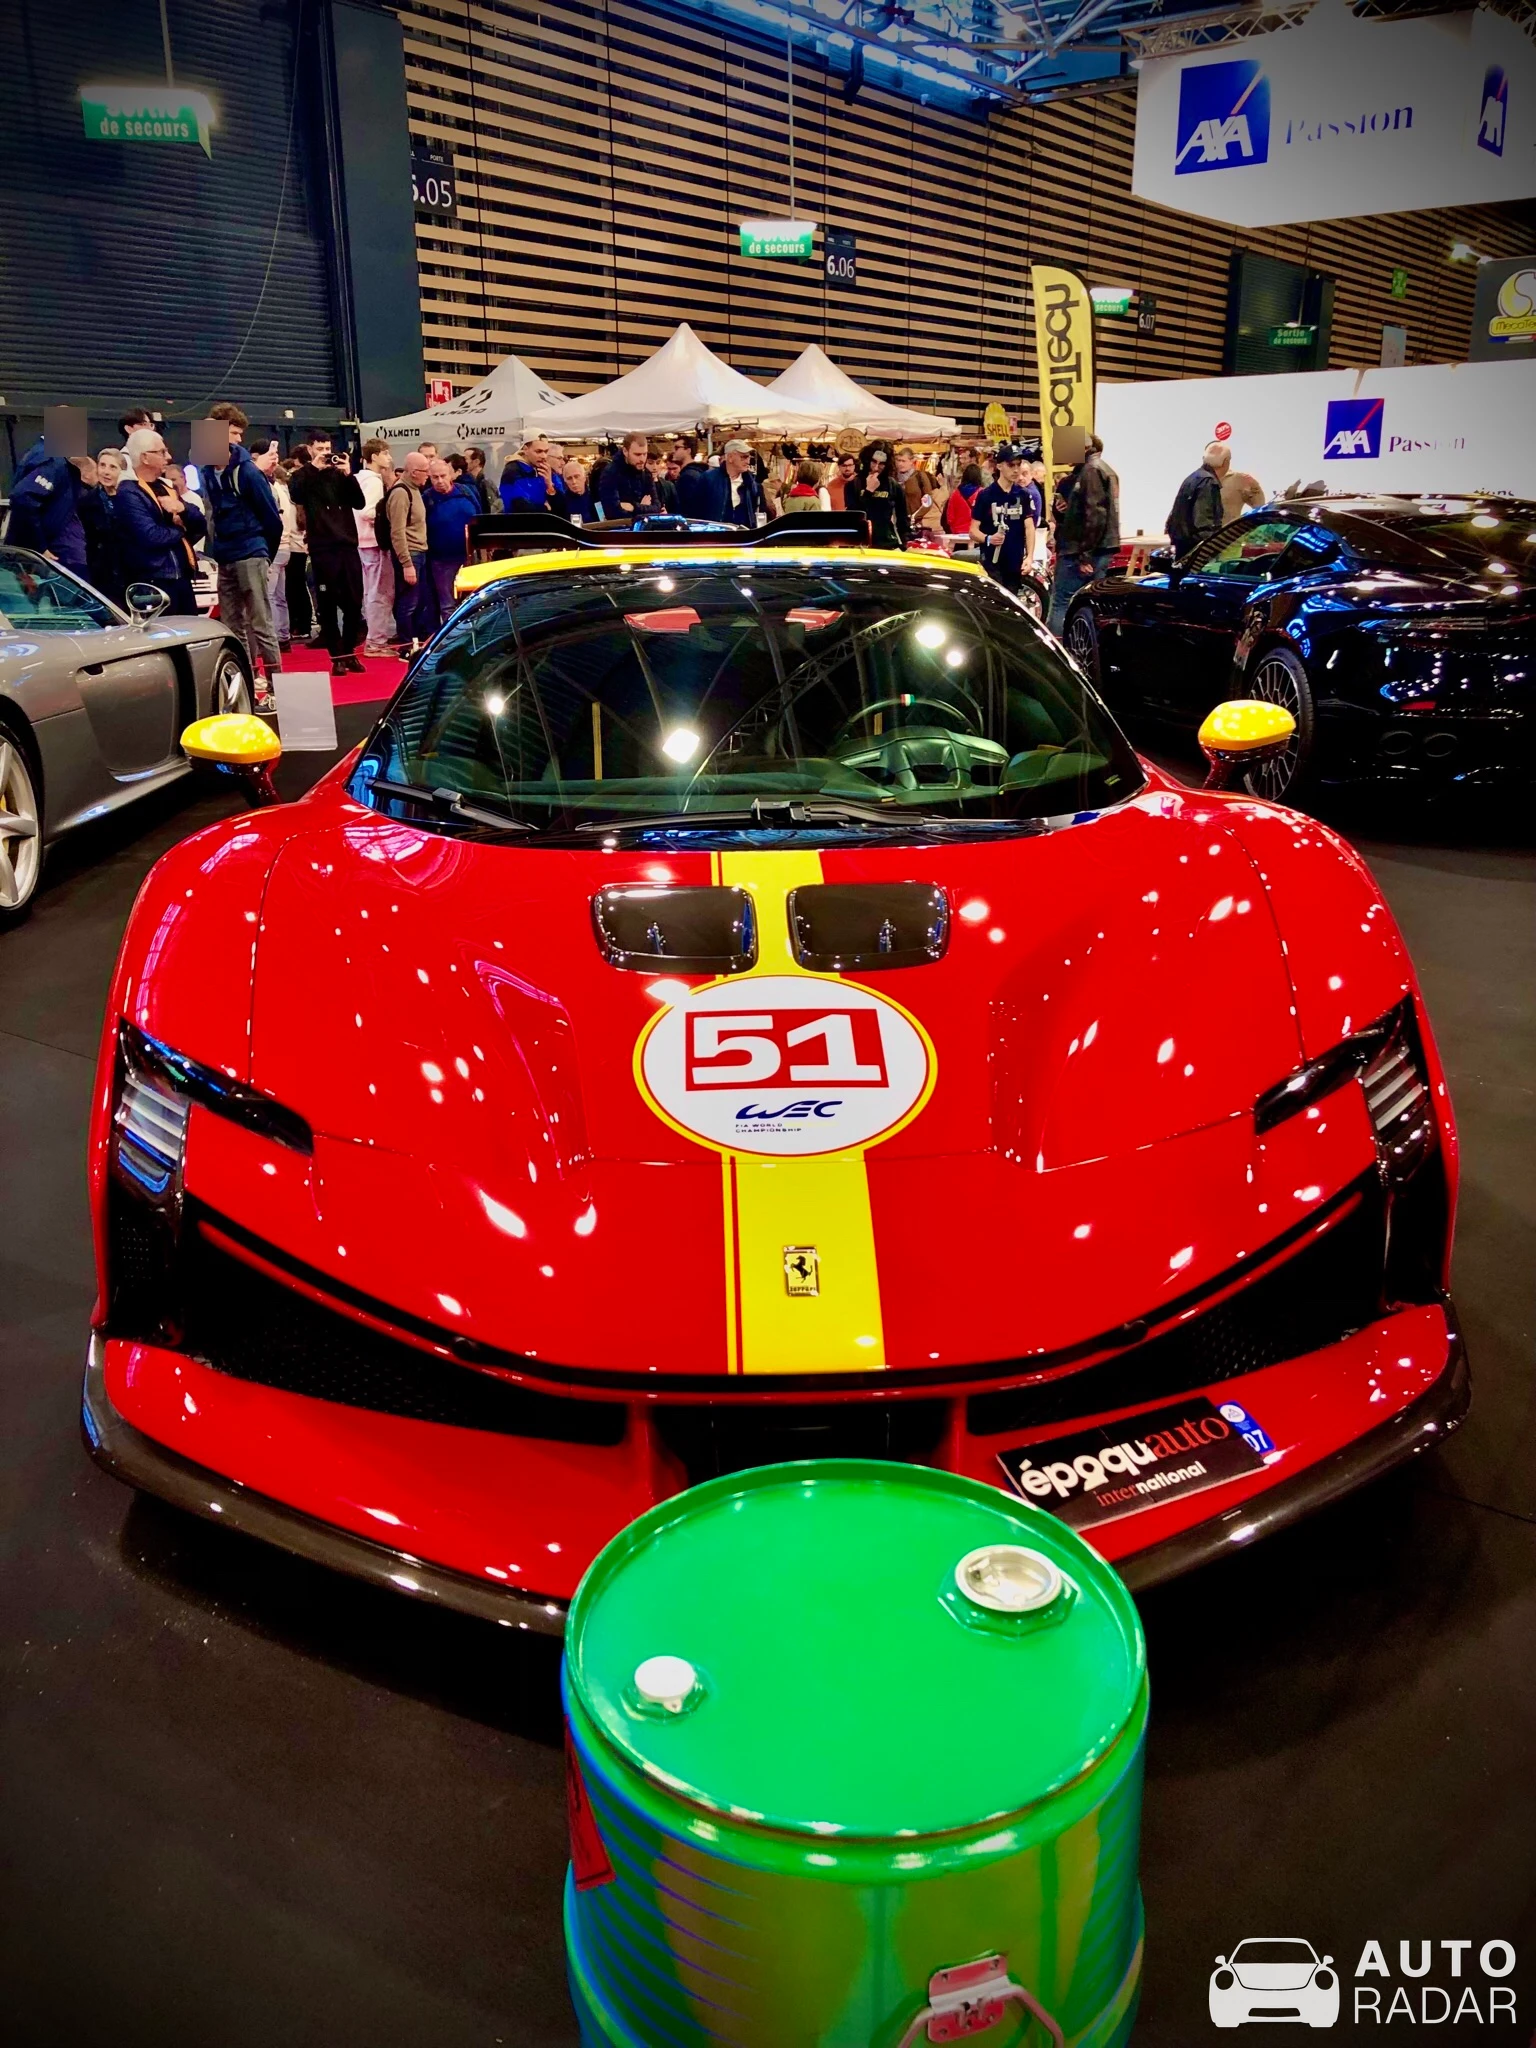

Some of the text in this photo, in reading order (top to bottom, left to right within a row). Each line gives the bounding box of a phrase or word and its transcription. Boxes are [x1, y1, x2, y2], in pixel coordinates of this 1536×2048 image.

[100, 117, 189, 138] de secours
[1175, 114, 1255, 166] AXA
[749, 242, 805, 254] de secours
[826, 255, 855, 278] 6.06
[1138, 313, 1155, 330] 6.07
[1277, 328, 1306, 337] Sortie
[388, 428, 420, 438] XLMOTO
[470, 426, 505, 436] XLMOTO
[987, 423, 1010, 438] SHELL
[1323, 429, 1372, 455] AXA
[692, 1014, 882, 1085] 51
[735, 1100, 843, 1119] WEC
[1242, 1429, 1269, 1453] 07
[1094, 1461, 1207, 1507] international
